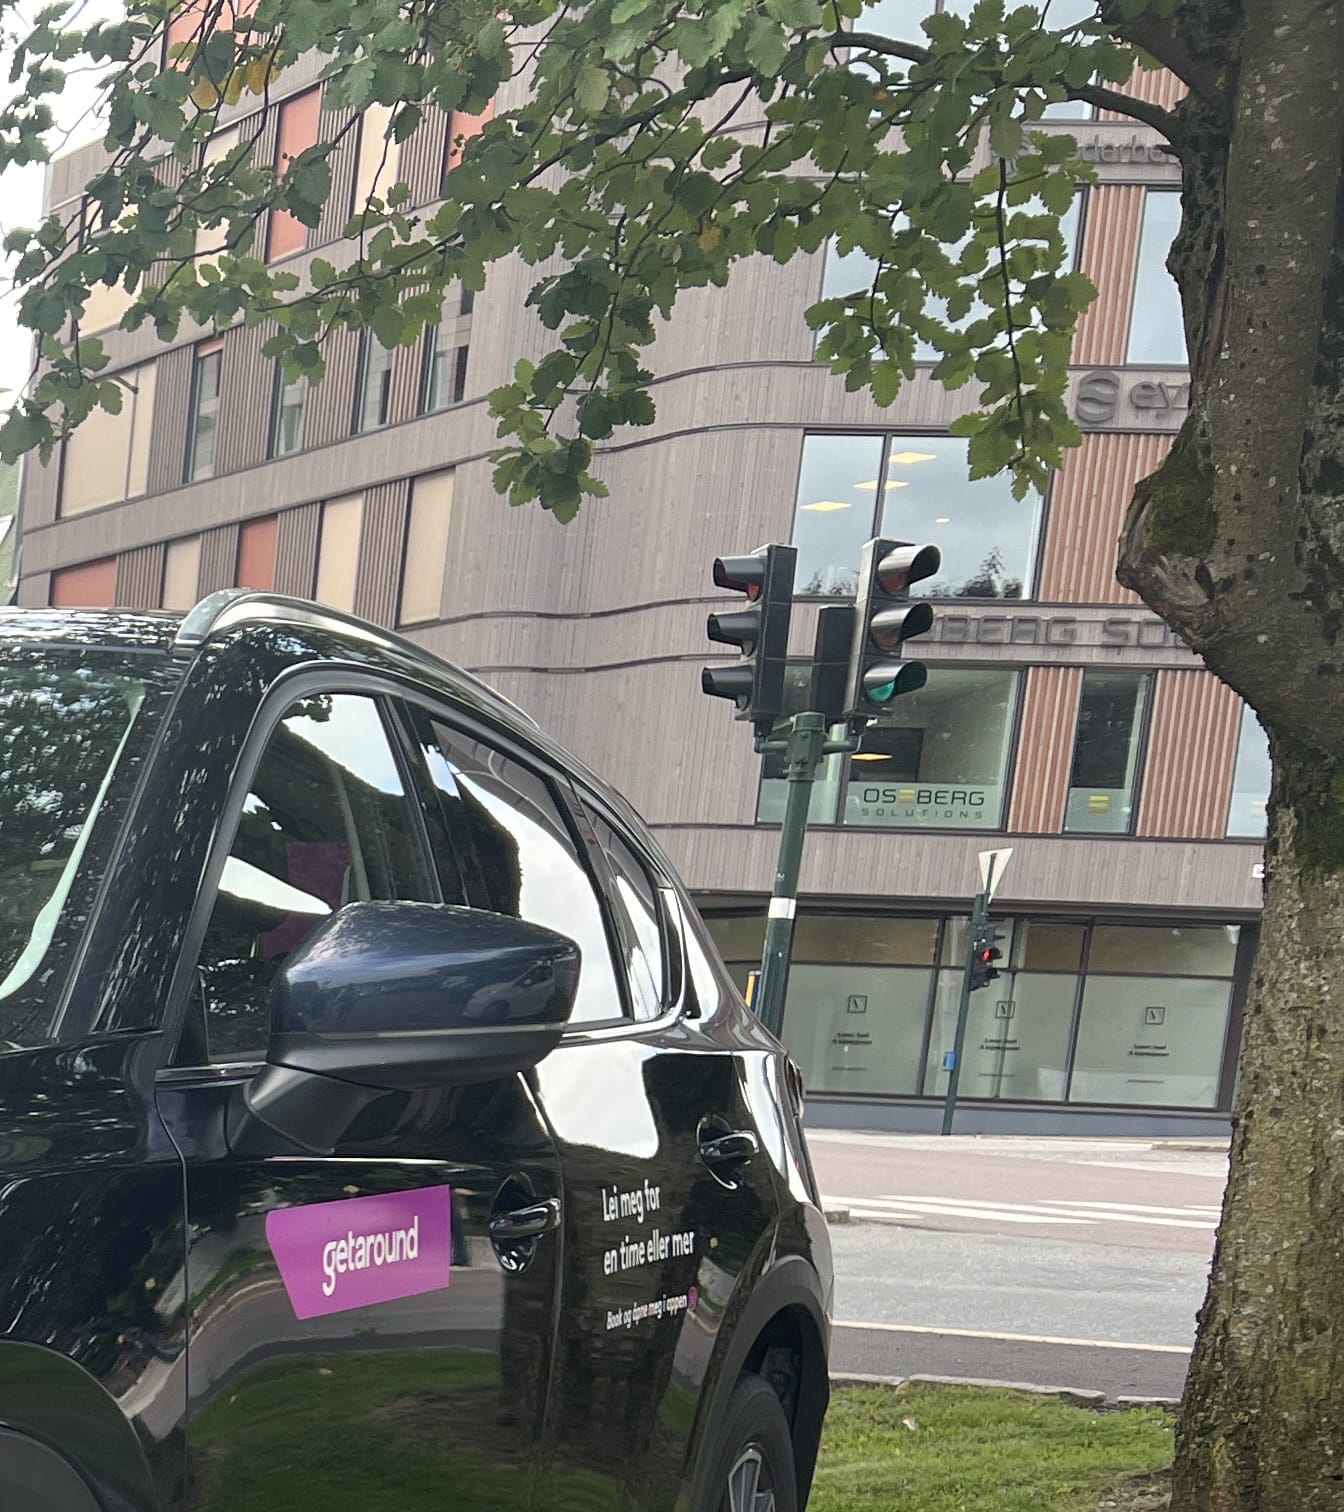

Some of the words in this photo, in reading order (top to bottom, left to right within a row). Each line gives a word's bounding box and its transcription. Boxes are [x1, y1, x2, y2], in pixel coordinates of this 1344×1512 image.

[926, 614, 1077, 646] BERG
[1103, 617, 1187, 647] SO
[861, 807, 984, 820] SOLUTIONS
[601, 1185, 619, 1222] Lei
[620, 1189, 644, 1224] meg
[644, 1178, 660, 1212] for
[322, 1215, 419, 1296] getaround
[603, 1249, 618, 1275] en
[619, 1234, 645, 1270] time
[646, 1228, 671, 1263] eller
[672, 1231, 695, 1257] mer
[623, 1309, 632, 1329] og
[648, 1300, 662, 1320] meg
